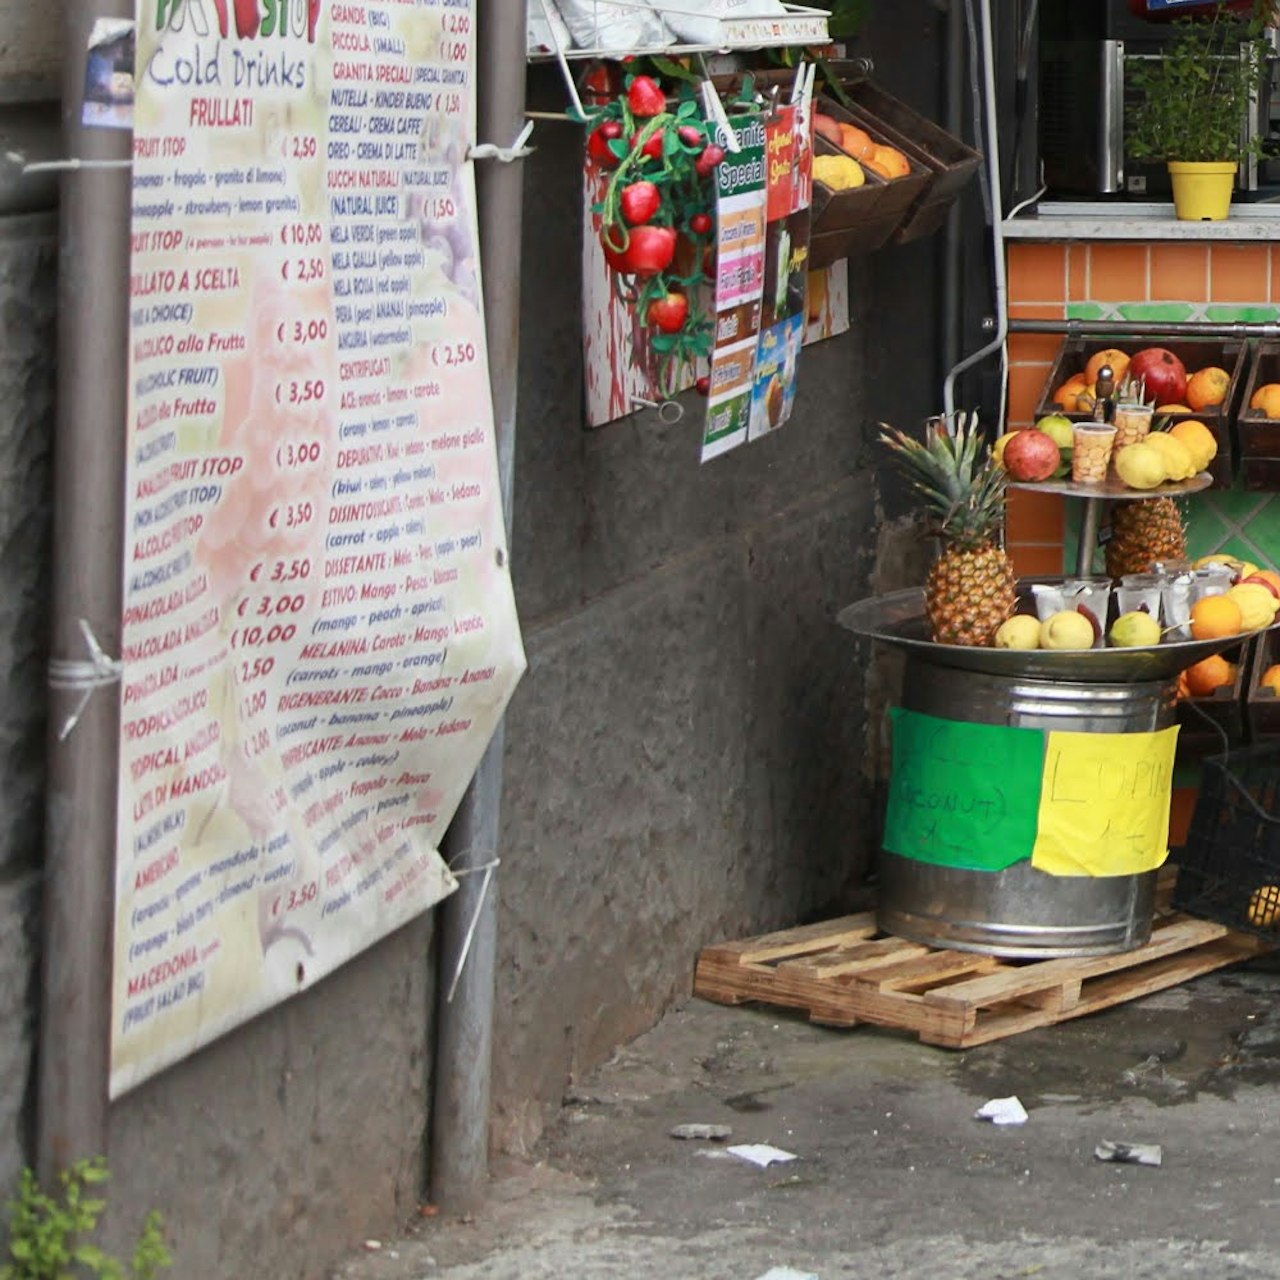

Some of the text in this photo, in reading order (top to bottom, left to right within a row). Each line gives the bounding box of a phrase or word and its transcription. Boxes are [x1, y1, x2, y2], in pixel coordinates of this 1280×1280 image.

[331, 2, 470, 36] GRANDE 2,00
[332, 32, 371, 53] PICCOLA
[148, 38, 305, 89] Cold Drinks
[333, 62, 413, 86] GRANITA SPECIALI
[330, 88, 432, 110] NUTELLA KINDER BUENO
[190, 99, 254, 128] FRULLATI
[328, 116, 395, 135] CEREALI CREMA
[162, 136, 317, 160] STOP 2,50
[327, 141, 385, 160] OREO CREMA
[358, 171, 399, 188] NATURALI
[291, 224, 322, 246] 10,00
[297, 259, 324, 280] 2,50
[208, 320, 328, 352] Frutta 3,00
[289, 380, 325, 406] 3,50
